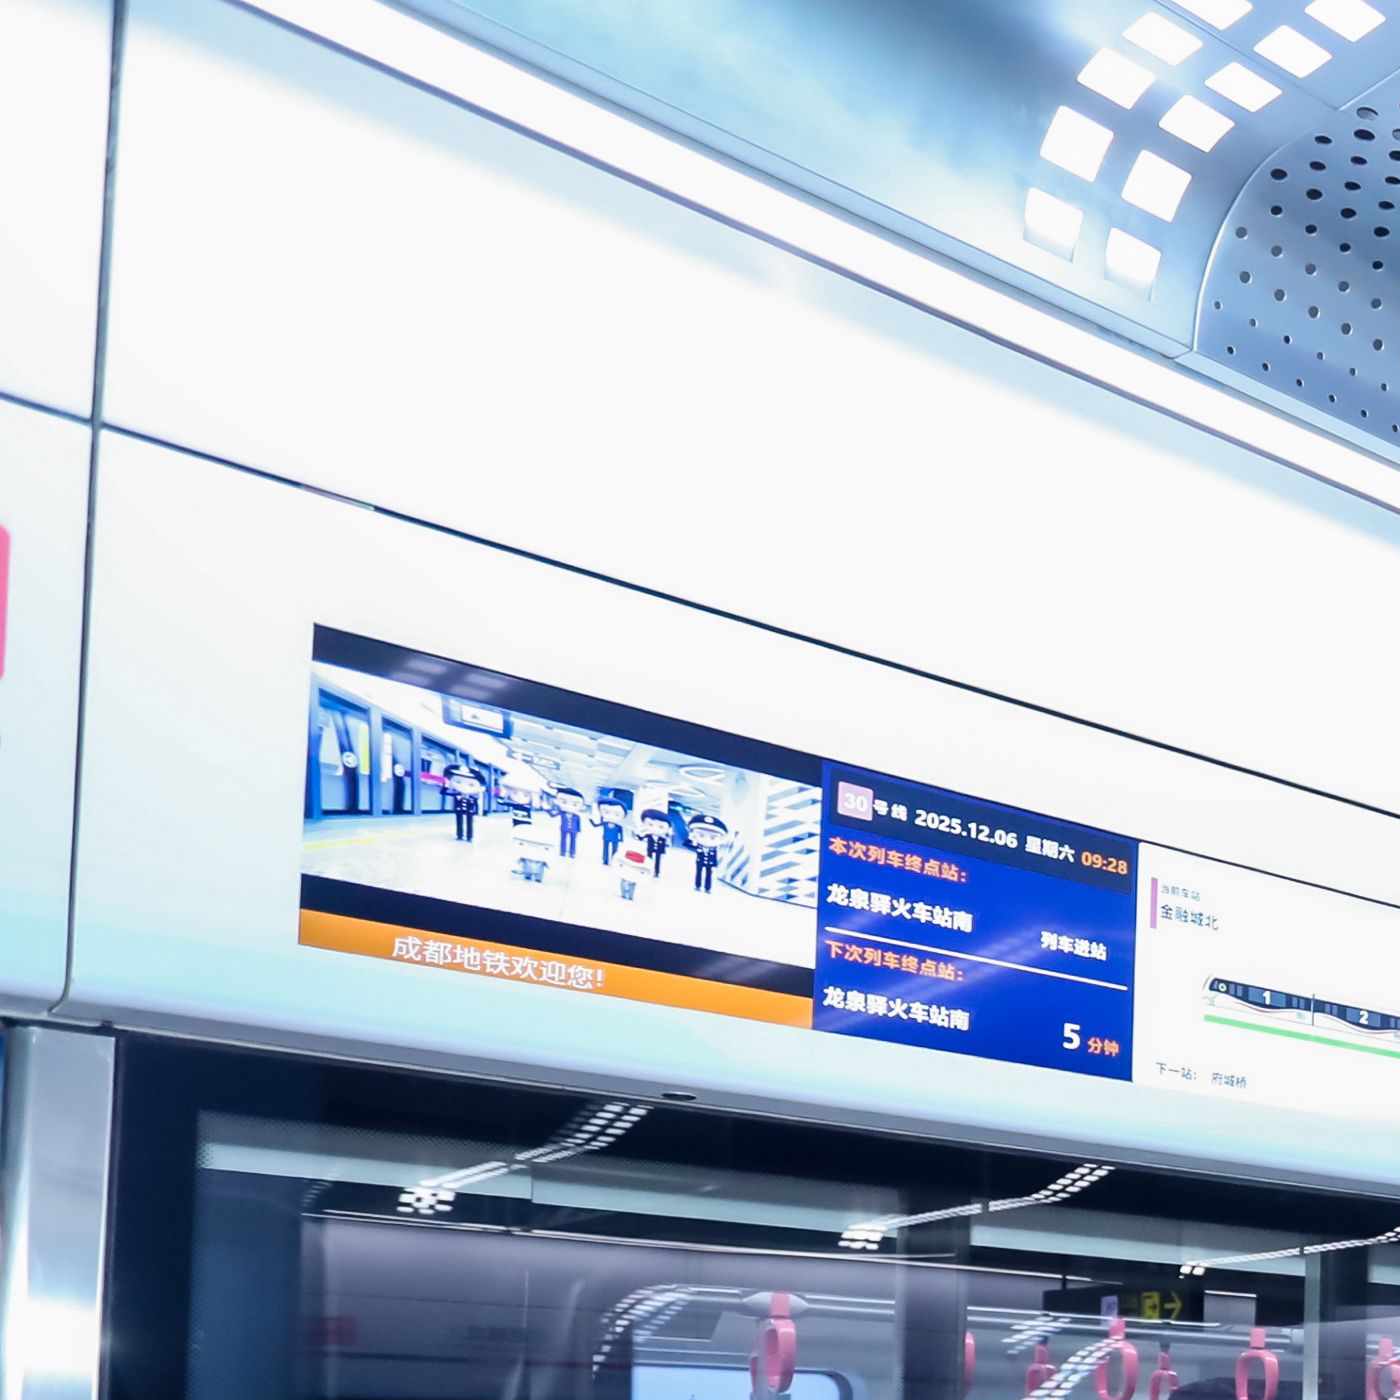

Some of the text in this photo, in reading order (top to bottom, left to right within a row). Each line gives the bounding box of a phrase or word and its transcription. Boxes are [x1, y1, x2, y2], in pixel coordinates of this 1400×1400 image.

[915, 809, 1018, 849] 2025.12.06
[1024, 836, 1076, 863] 星期六
[1081, 851, 1128, 875] 09:28
[826, 883, 973, 932] 龙泉驿火车站南
[1160, 904, 1219, 930] 金融城北
[1040, 930, 1107, 961] 列车进站
[822, 986, 971, 1031] 龙泉驿火车站南
[1262, 990, 1271, 1005] 1
[1359, 1010, 1369, 1024] 2
[1062, 1022, 1120, 1057] 5 分钟
